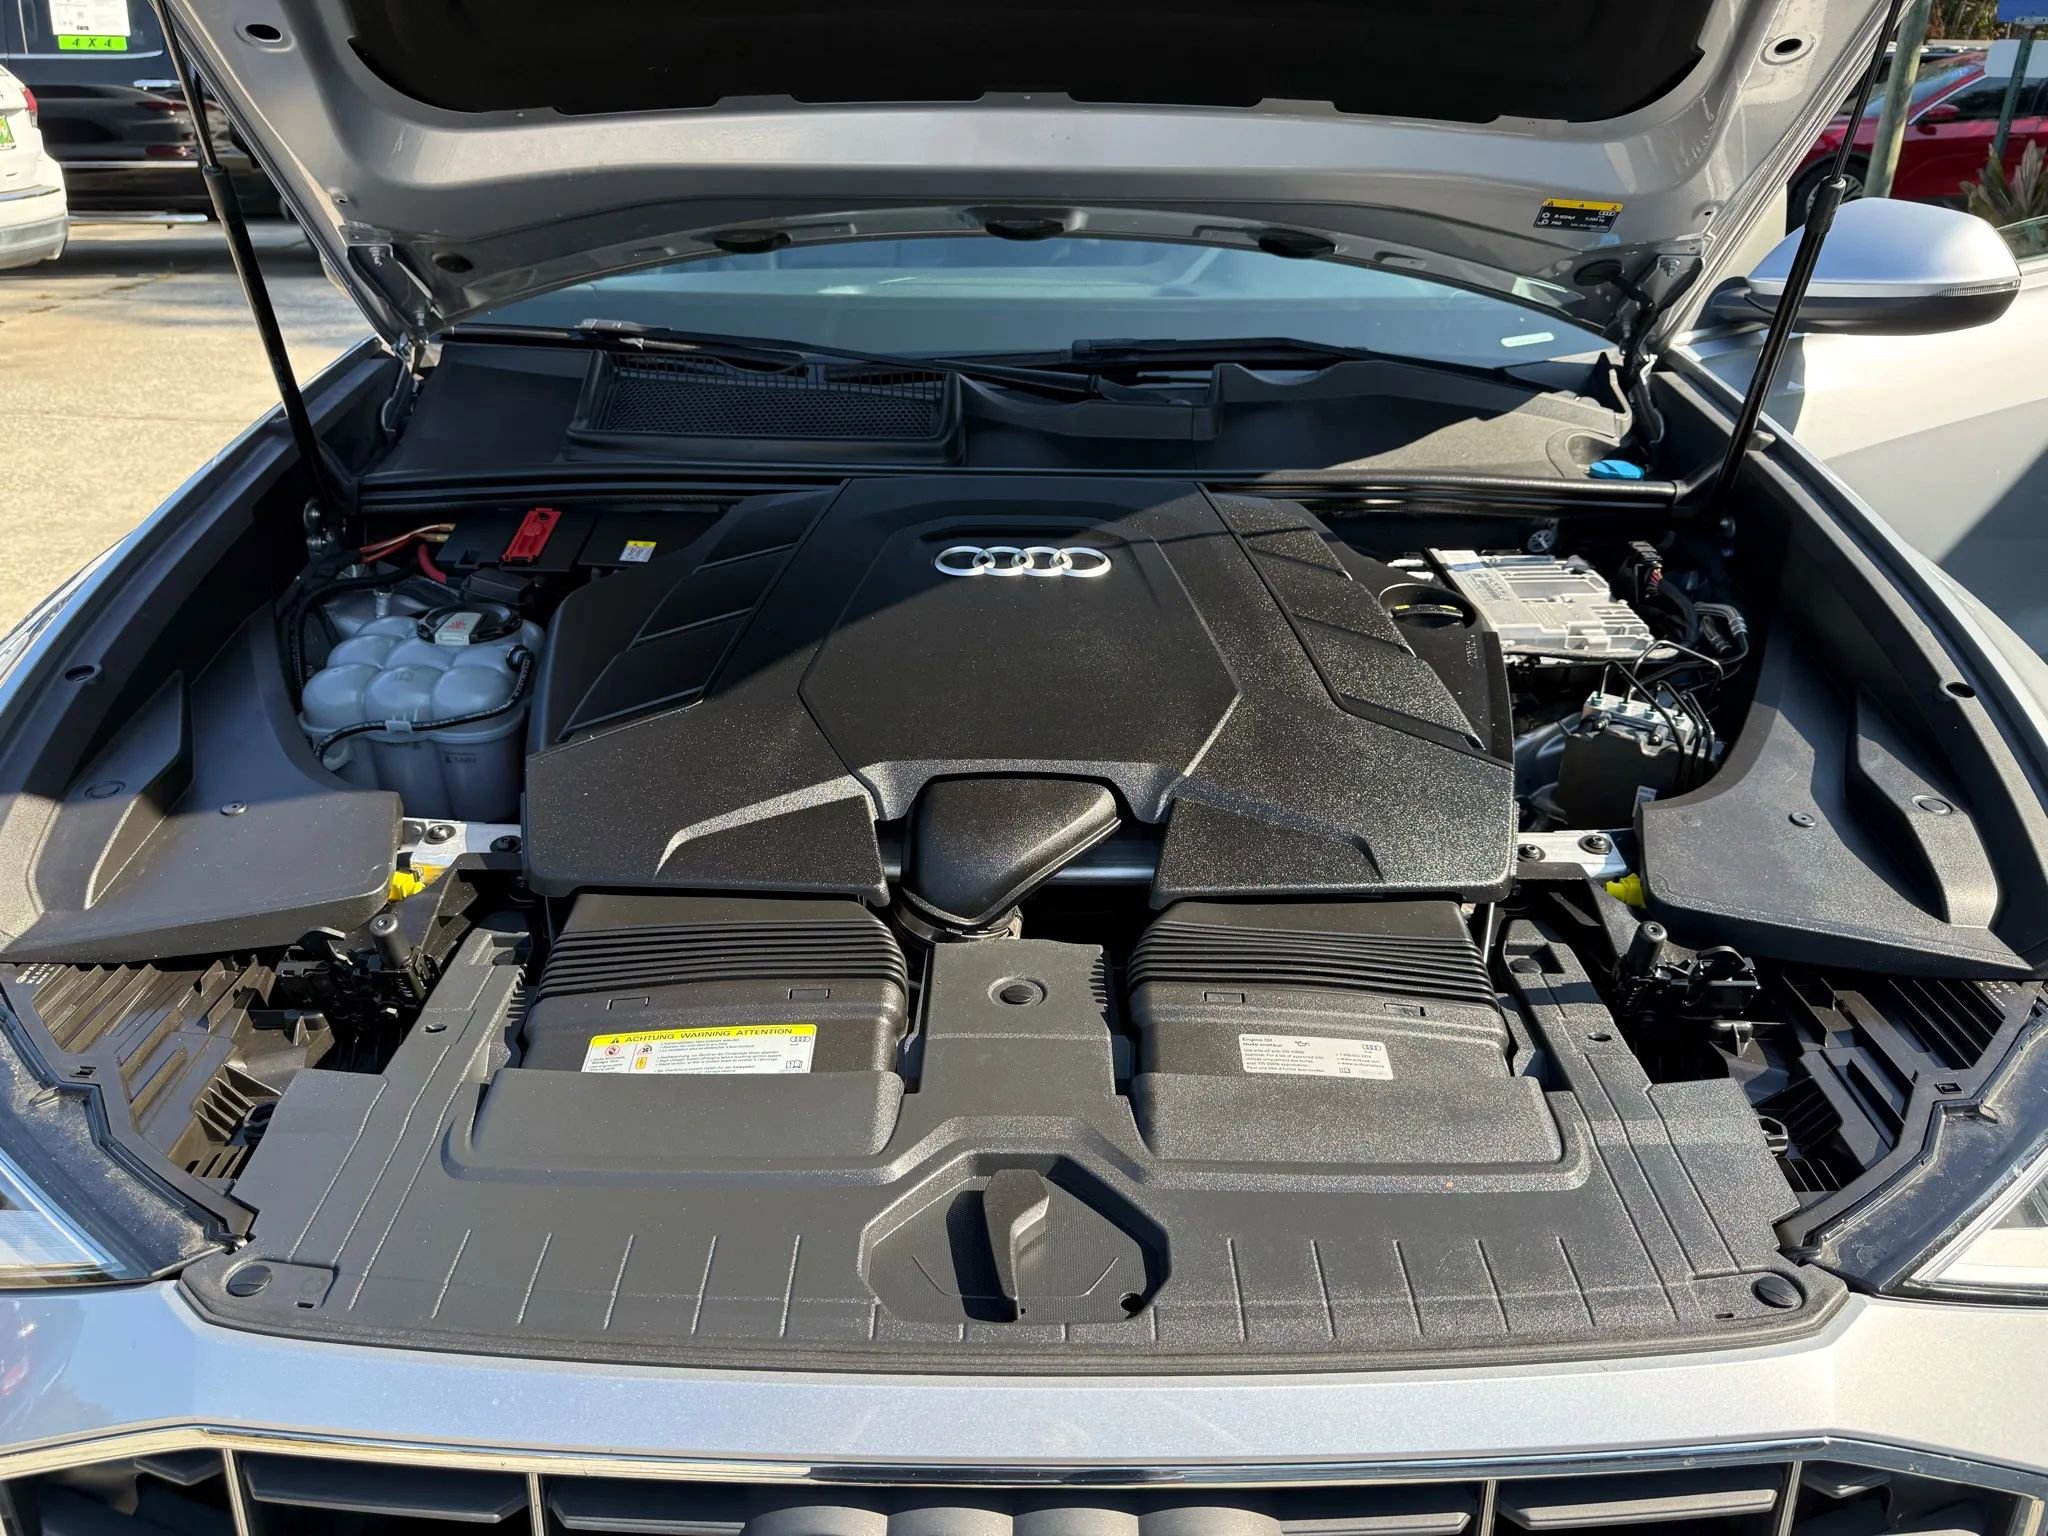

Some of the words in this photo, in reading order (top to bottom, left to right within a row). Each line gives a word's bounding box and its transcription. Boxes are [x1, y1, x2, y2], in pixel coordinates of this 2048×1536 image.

[72, 38, 80, 47] 4
[104, 38, 112, 47] 4
[624, 1033, 675, 1043] ACHTUNG
[680, 1030, 731, 1039] WARNING
[735, 1028, 793, 1036] ATTENTION
